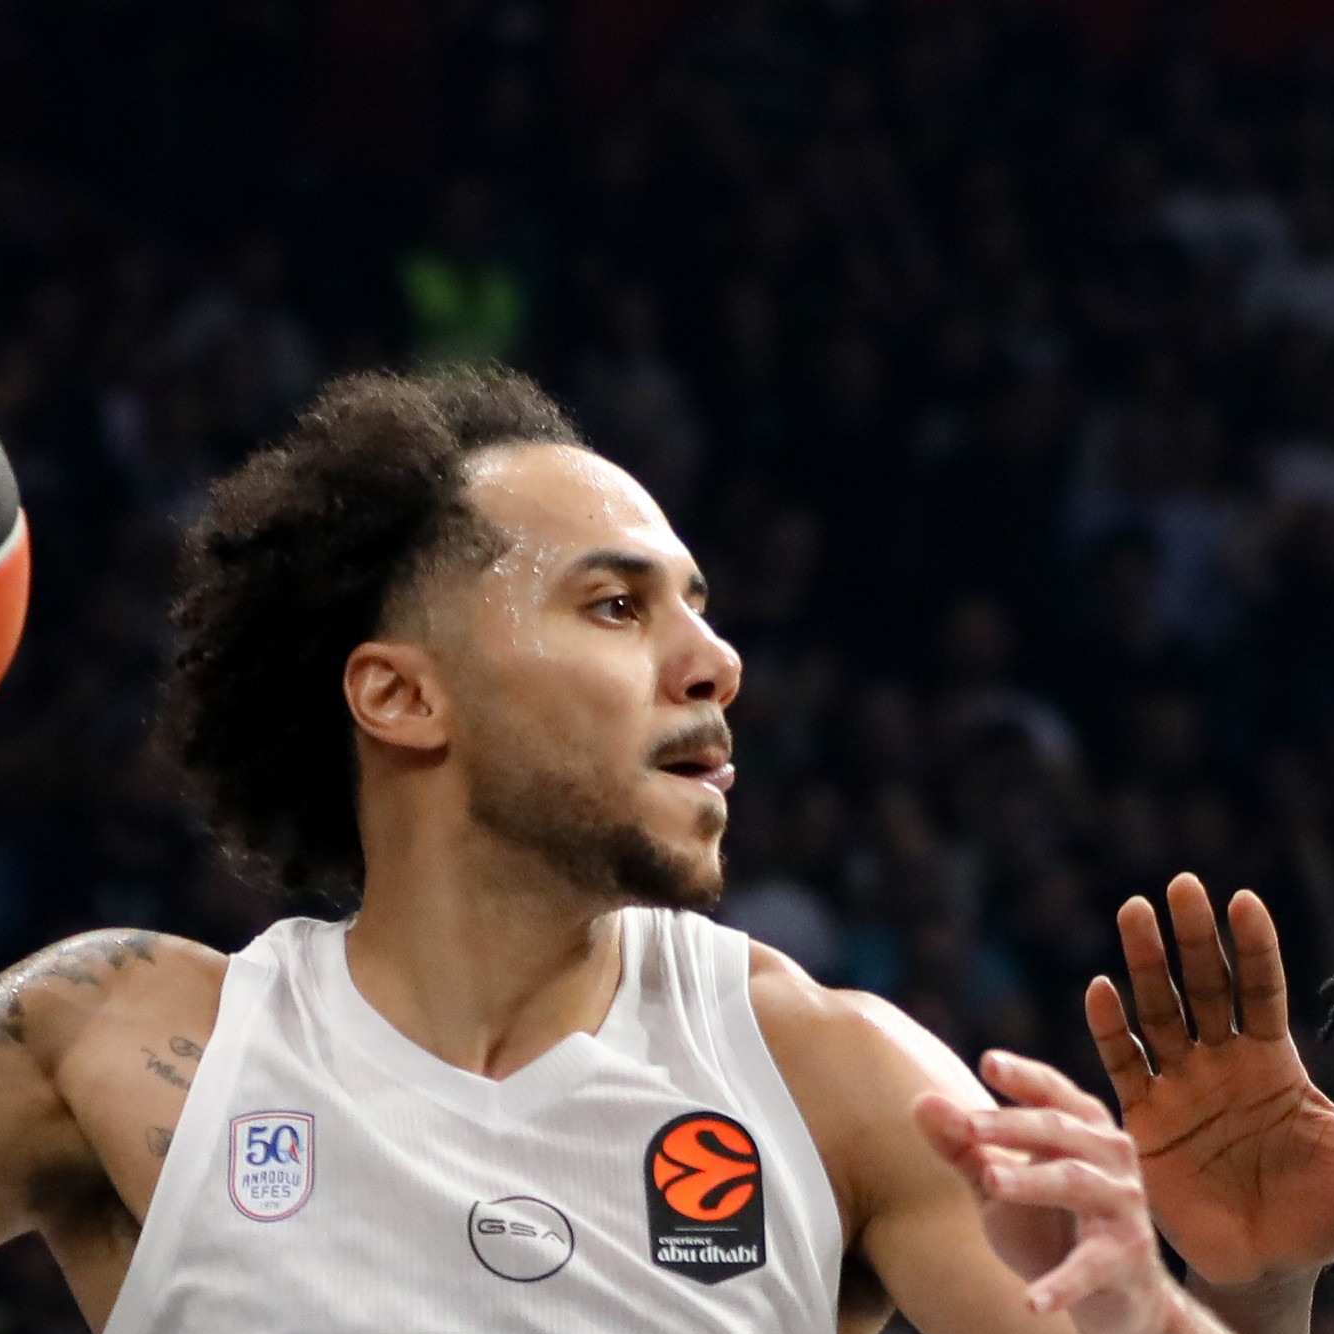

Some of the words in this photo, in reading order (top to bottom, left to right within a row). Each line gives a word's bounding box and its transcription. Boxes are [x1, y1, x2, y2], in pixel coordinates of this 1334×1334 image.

[245, 1125, 300, 1166] 50
[242, 1170, 302, 1188] ANADOLU
[251, 1185, 291, 1199] EFES
[478, 1219, 565, 1244] GSA
[657, 1246, 697, 1262] abu
[699, 1244, 758, 1263] dhabi
